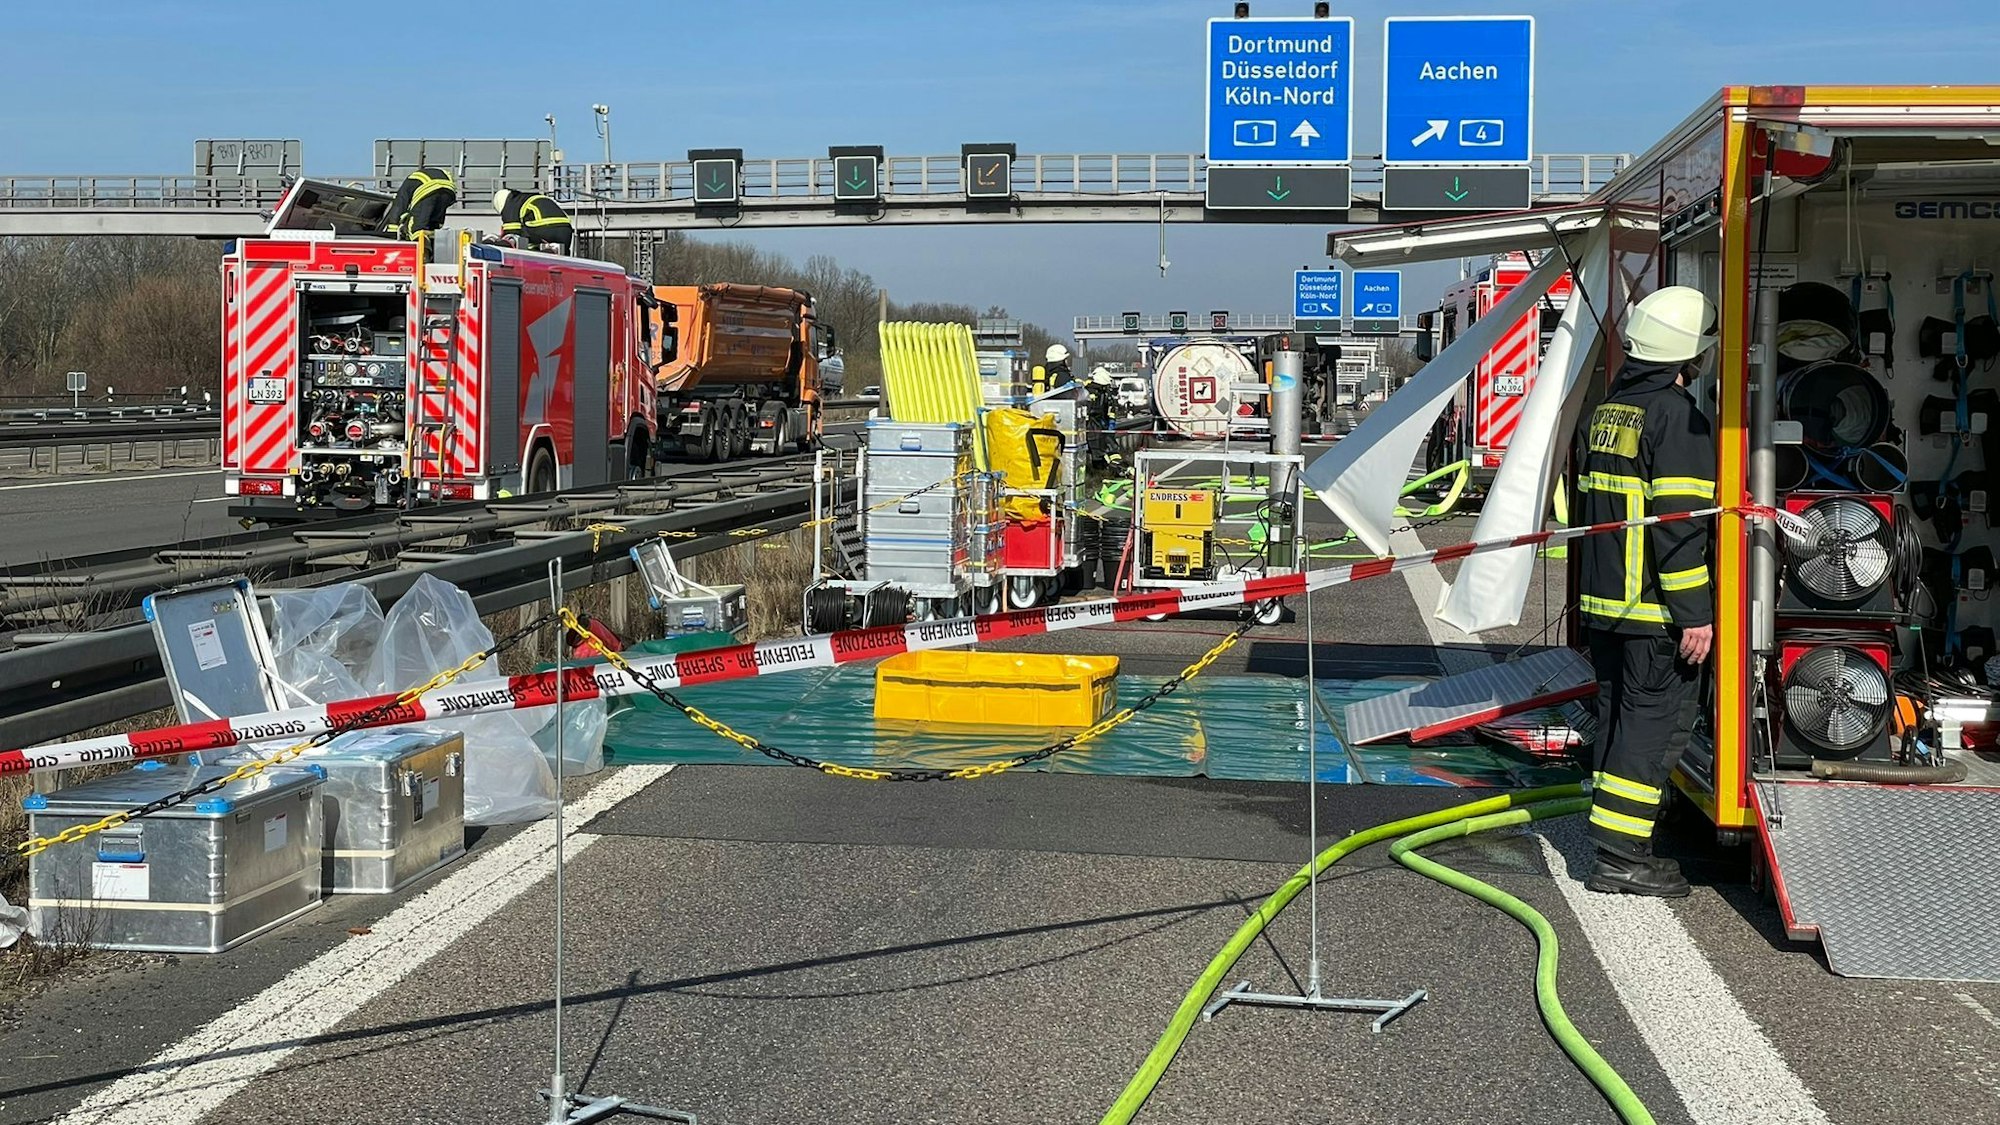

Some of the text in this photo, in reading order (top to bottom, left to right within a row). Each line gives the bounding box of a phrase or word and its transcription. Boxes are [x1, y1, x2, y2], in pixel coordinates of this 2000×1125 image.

[1228, 36, 1332, 54] Dortmund
[1221, 60, 1338, 79] Düsseldorf
[1419, 61, 1498, 80] Aachen
[1225, 87, 1334, 105] Köln-Nord
[1252, 125, 1259, 141] 1
[1475, 125, 1487, 141] 4
[1299, 283, 1338, 291] Düsseldorf
[1301, 275, 1337, 283] Dortmund
[1300, 292, 1337, 300] Köln-Nord
[265, 380, 271, 389] K
[251, 390, 282, 399] LN 393
[1150, 492, 1188, 502] ENDRESS
[919, 619, 991, 642] FEUERWEHR
[835, 628, 907, 654] SPERRZONE
[736, 643, 816, 669] FEUERWEHR
[646, 655, 725, 681] SPERRZONE
[541, 671, 626, 697] FEUERWHR
[437, 684, 527, 712] SPERRZONE
[208, 719, 306, 744] SPERRZONE
